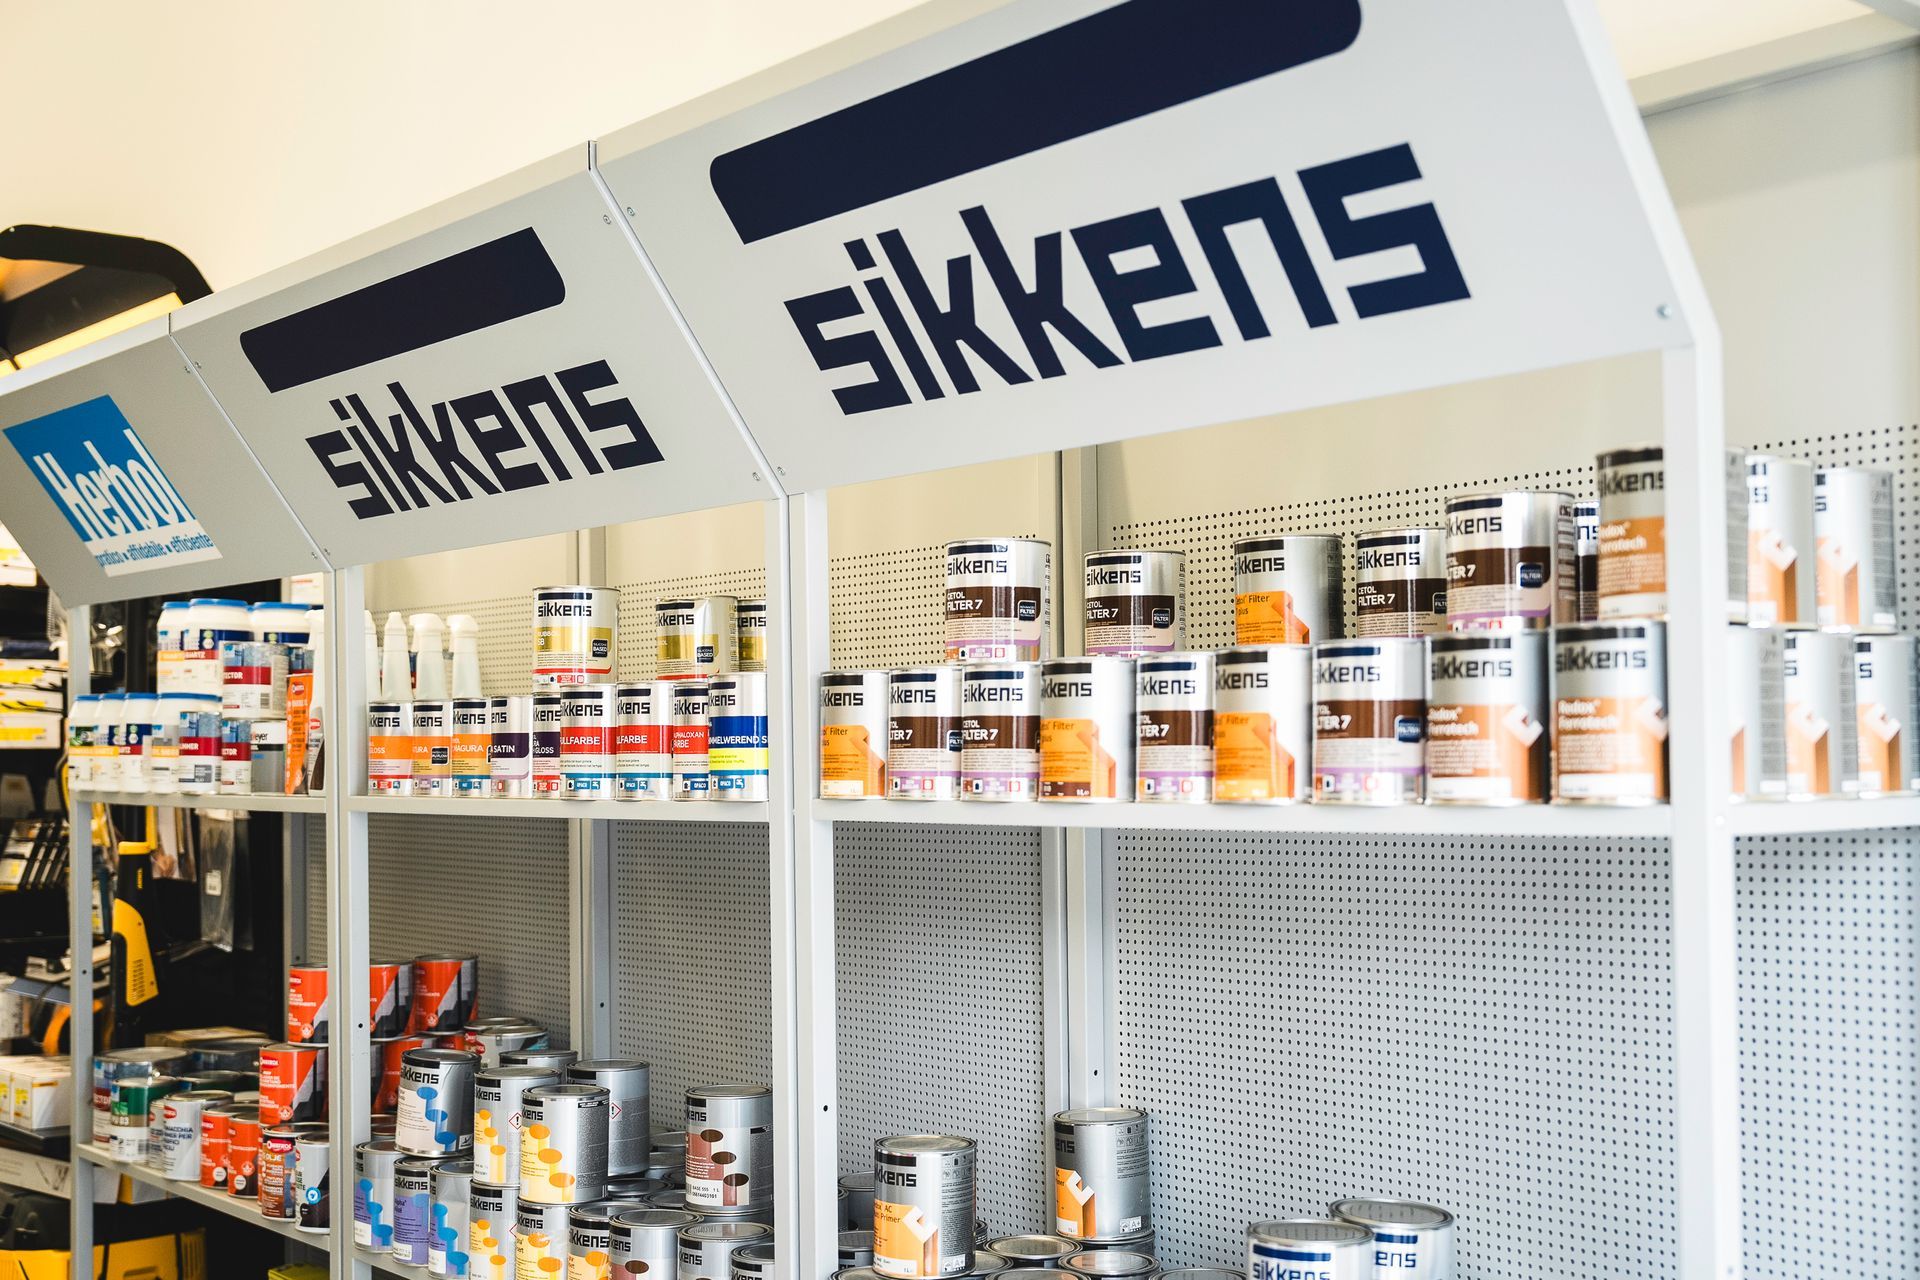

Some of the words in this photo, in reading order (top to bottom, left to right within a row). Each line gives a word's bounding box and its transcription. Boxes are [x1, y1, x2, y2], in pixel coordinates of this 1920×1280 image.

[783, 142, 1471, 415] sikkens
[305, 359, 665, 520] sikkens
[33, 428, 196, 541] Herbol
[170, 533, 214, 554] efficiente
[947, 557, 1008, 576] sikkens
[1357, 550, 1421, 571] sikkens
[1086, 568, 1142, 586] sikkens
[1467, 564, 1476, 579] 7
[975, 599, 984, 610] 7
[1249, 594, 1270, 604] Filter
[1387, 593, 1396, 606] 7
[537, 601, 592, 618] sikkens
[1111, 608, 1119, 619] 7
[657, 612, 695, 628] kkens
[1555, 646, 1647, 673] sikkens
[963, 683, 1024, 703] sikkens
[1159, 723, 1170, 738] 7
[1340, 714, 1353, 731] 7
[906, 729, 914, 741] 7
[989, 728, 999, 742] 7
[493, 744, 516, 754] SATIN
